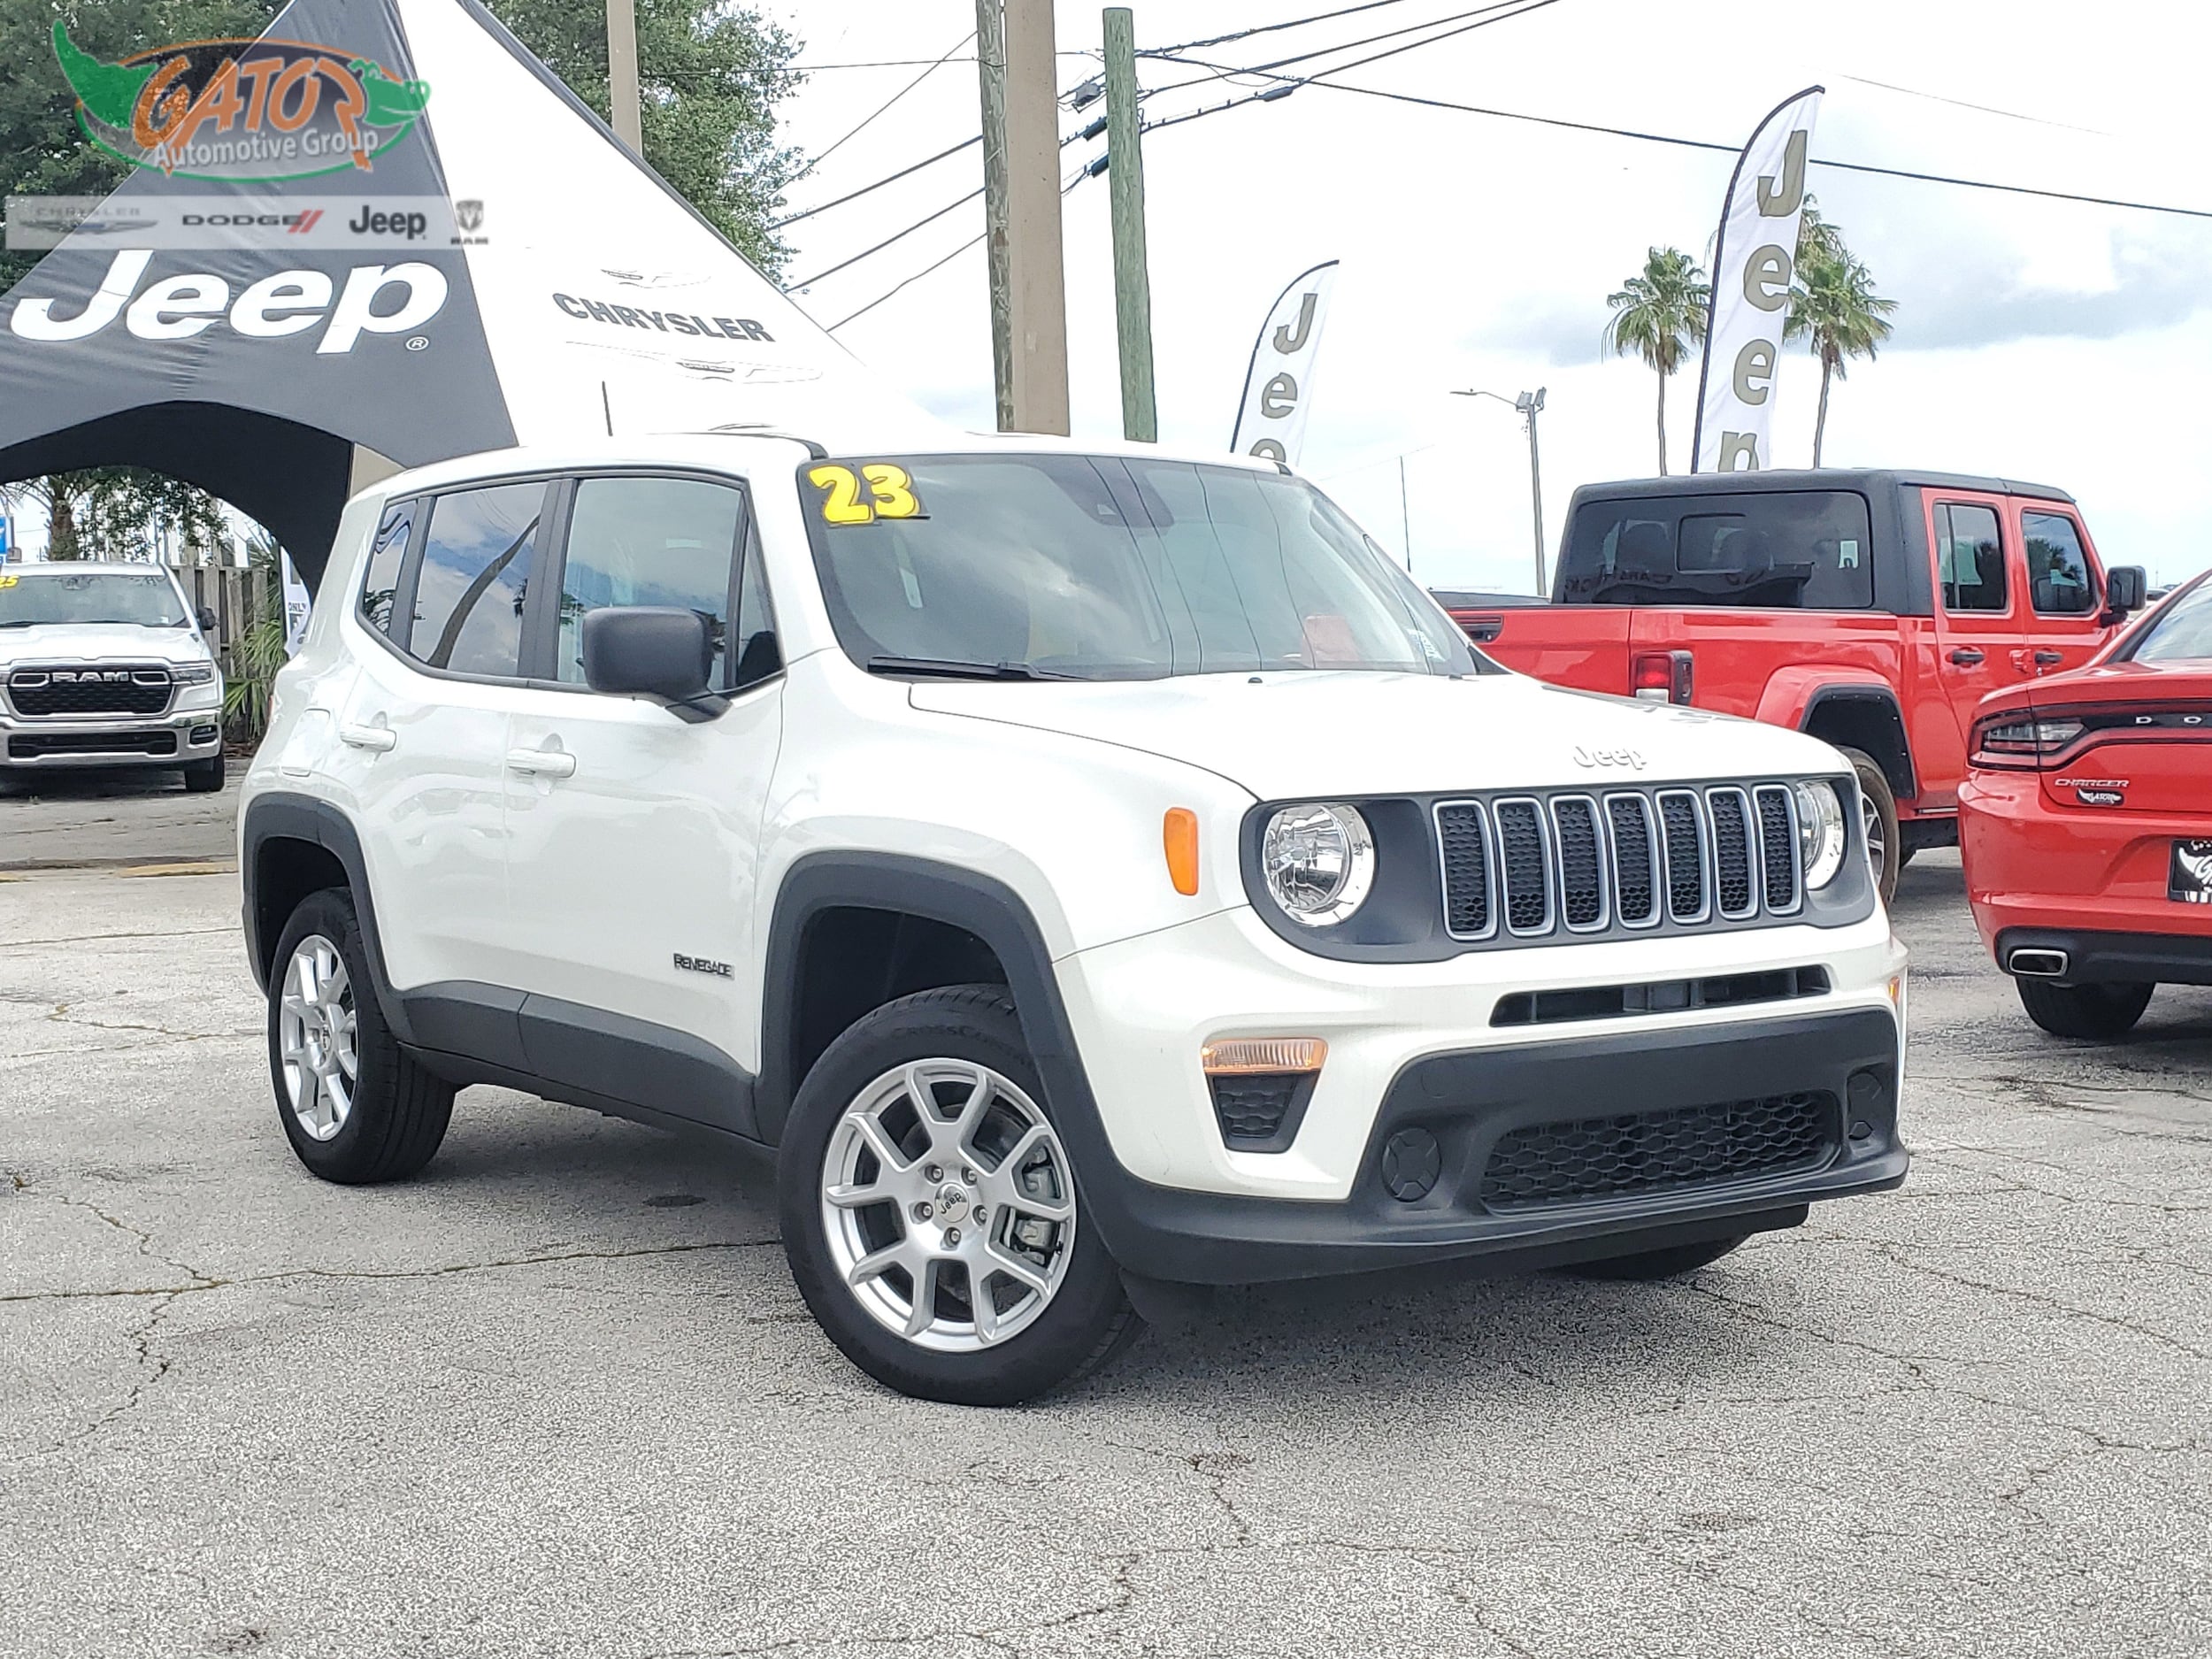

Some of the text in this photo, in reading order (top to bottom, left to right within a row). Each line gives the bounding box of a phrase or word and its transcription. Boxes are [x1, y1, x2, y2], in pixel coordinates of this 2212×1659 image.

[11, 250, 449, 354] Jeep
[552, 293, 776, 342] CHRYSLER
[808, 464, 921, 526] 23
[52, 672, 129, 682] RAM
[1573, 746, 1647, 771] Jeep
[2055, 779, 2130, 787] CHARGER
[673, 953, 735, 979] RENEGADE
[941, 1193, 962, 1214] Jeep
